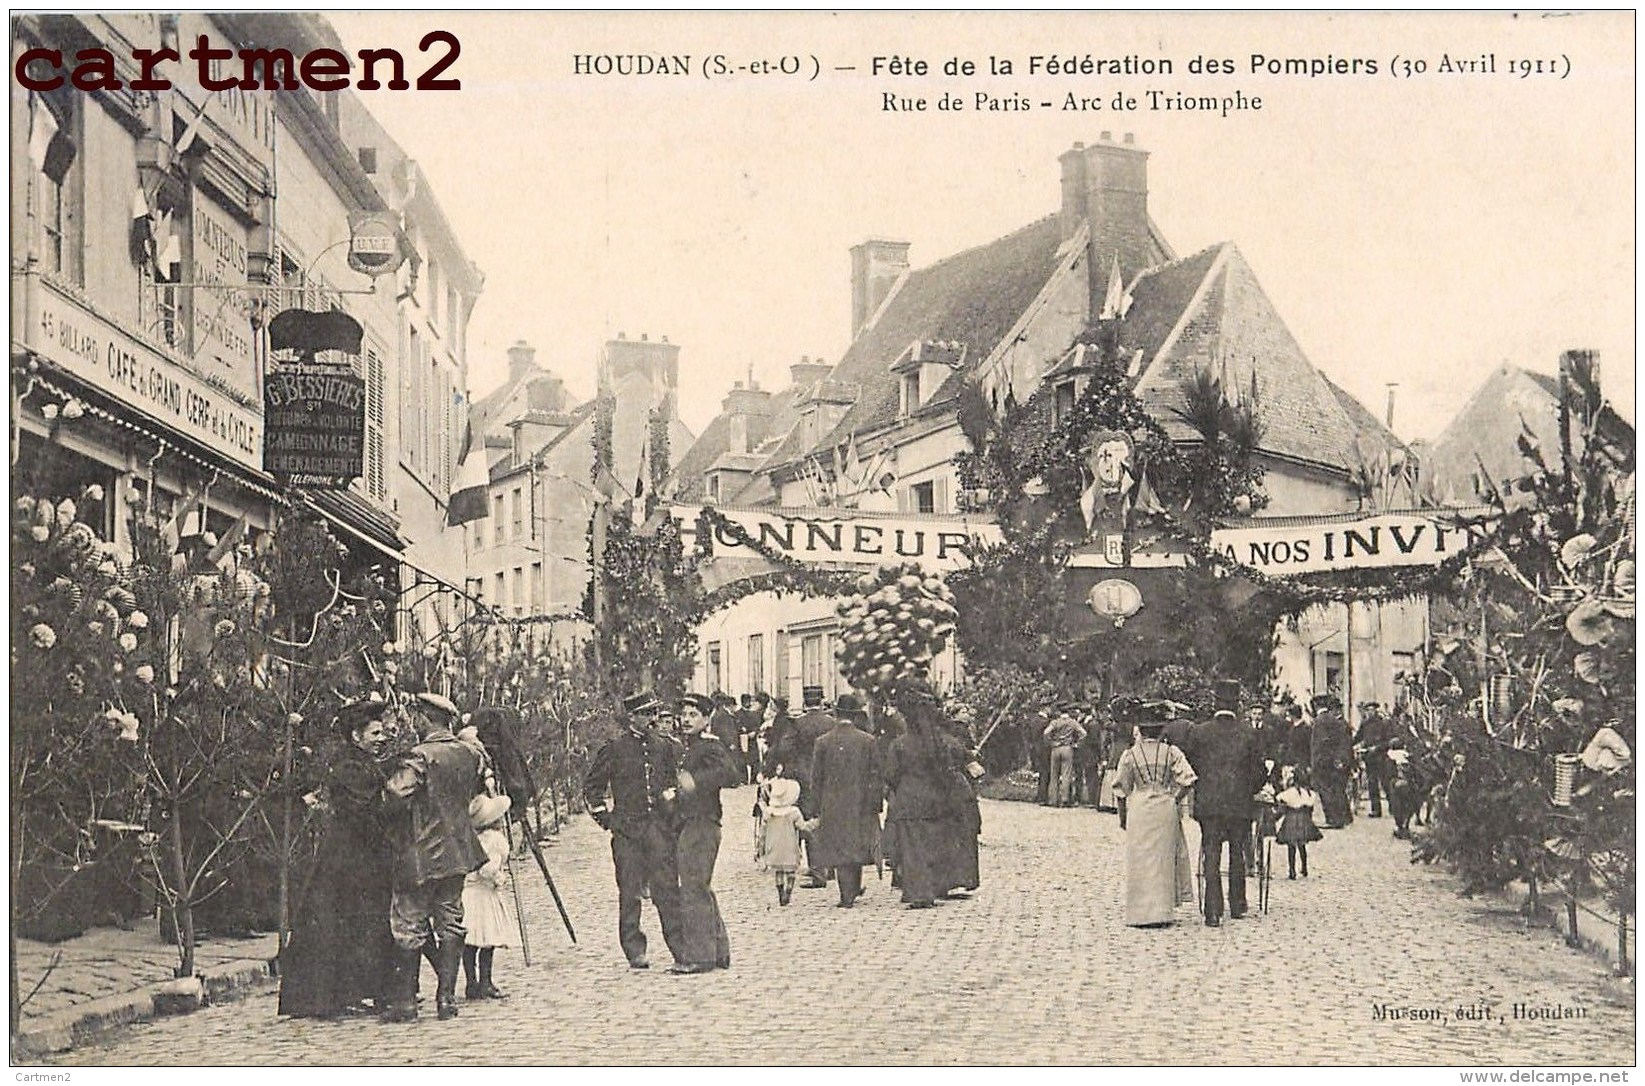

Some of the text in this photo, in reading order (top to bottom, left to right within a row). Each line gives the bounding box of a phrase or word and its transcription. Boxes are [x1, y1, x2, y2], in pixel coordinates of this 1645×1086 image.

[60, 320, 99, 364] BILLARD
[149, 367, 180, 415] GRAND
[186, 388, 211, 428] CERF
[229, 412, 254, 454] CYCLE
[1249, 539, 1310, 566] NOS
